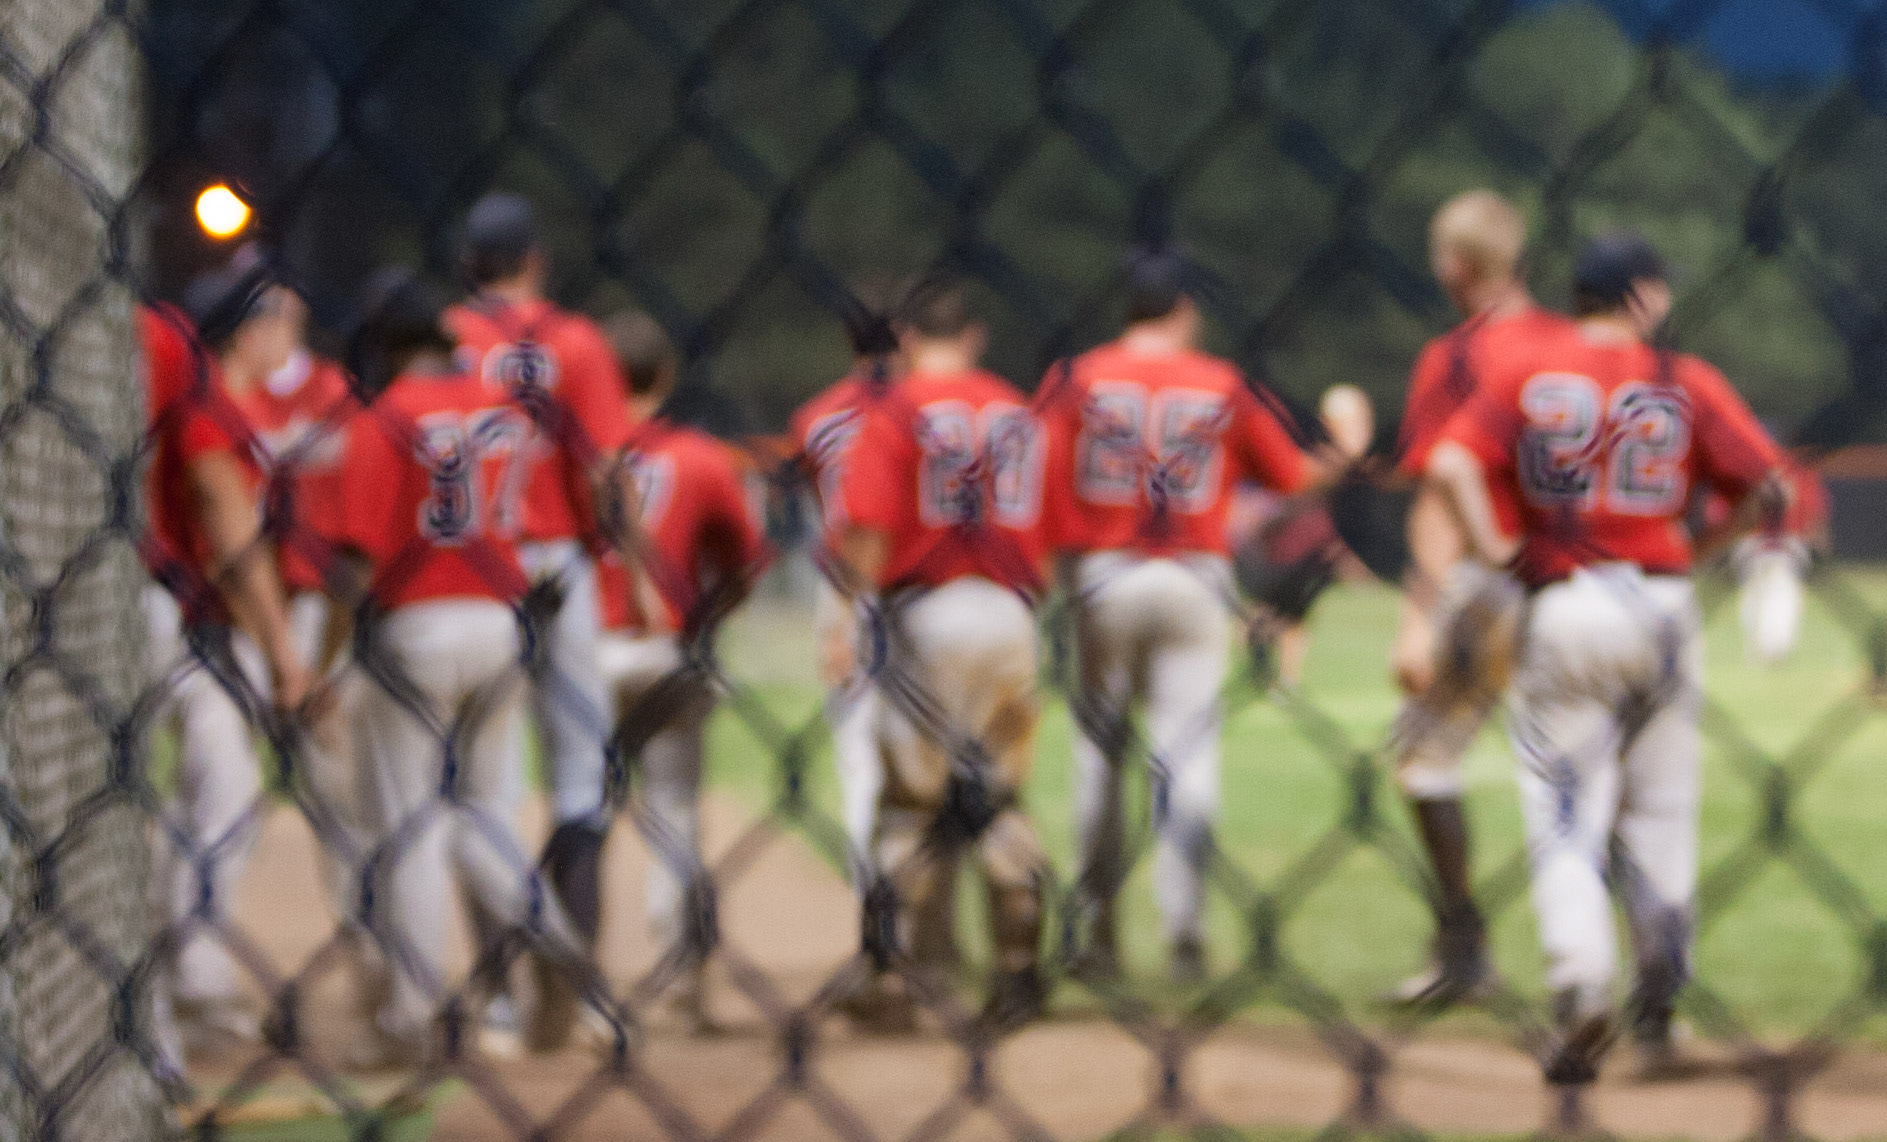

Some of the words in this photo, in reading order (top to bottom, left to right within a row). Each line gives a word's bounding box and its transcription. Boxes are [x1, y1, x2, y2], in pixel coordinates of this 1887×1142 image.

[414, 407, 540, 546] 37
[1075, 380, 1235, 514] 25
[1517, 371, 1695, 517] 22
